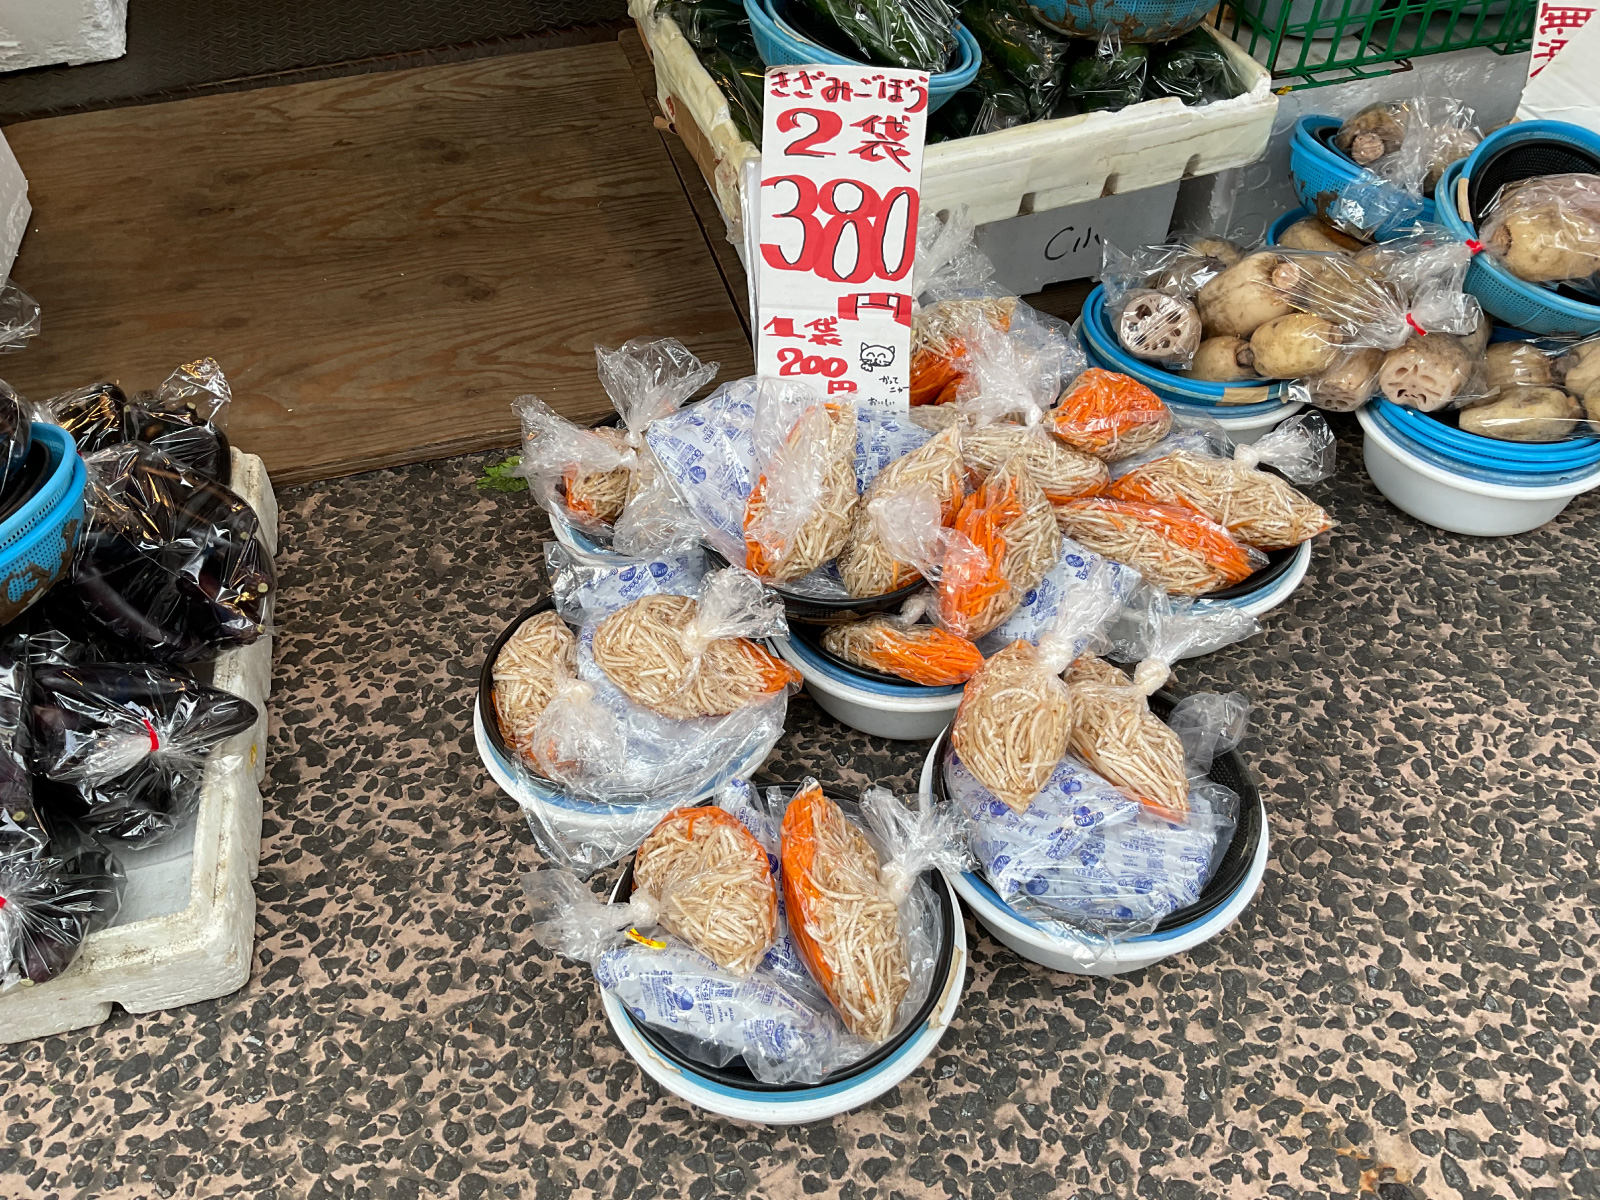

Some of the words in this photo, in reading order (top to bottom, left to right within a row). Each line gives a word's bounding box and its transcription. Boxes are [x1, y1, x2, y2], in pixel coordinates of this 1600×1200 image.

[770, 71, 929, 113] きざみごぼう
[760, 175, 919, 283] 380
[777, 348, 849, 377] 200
[828, 379, 857, 396] 円
